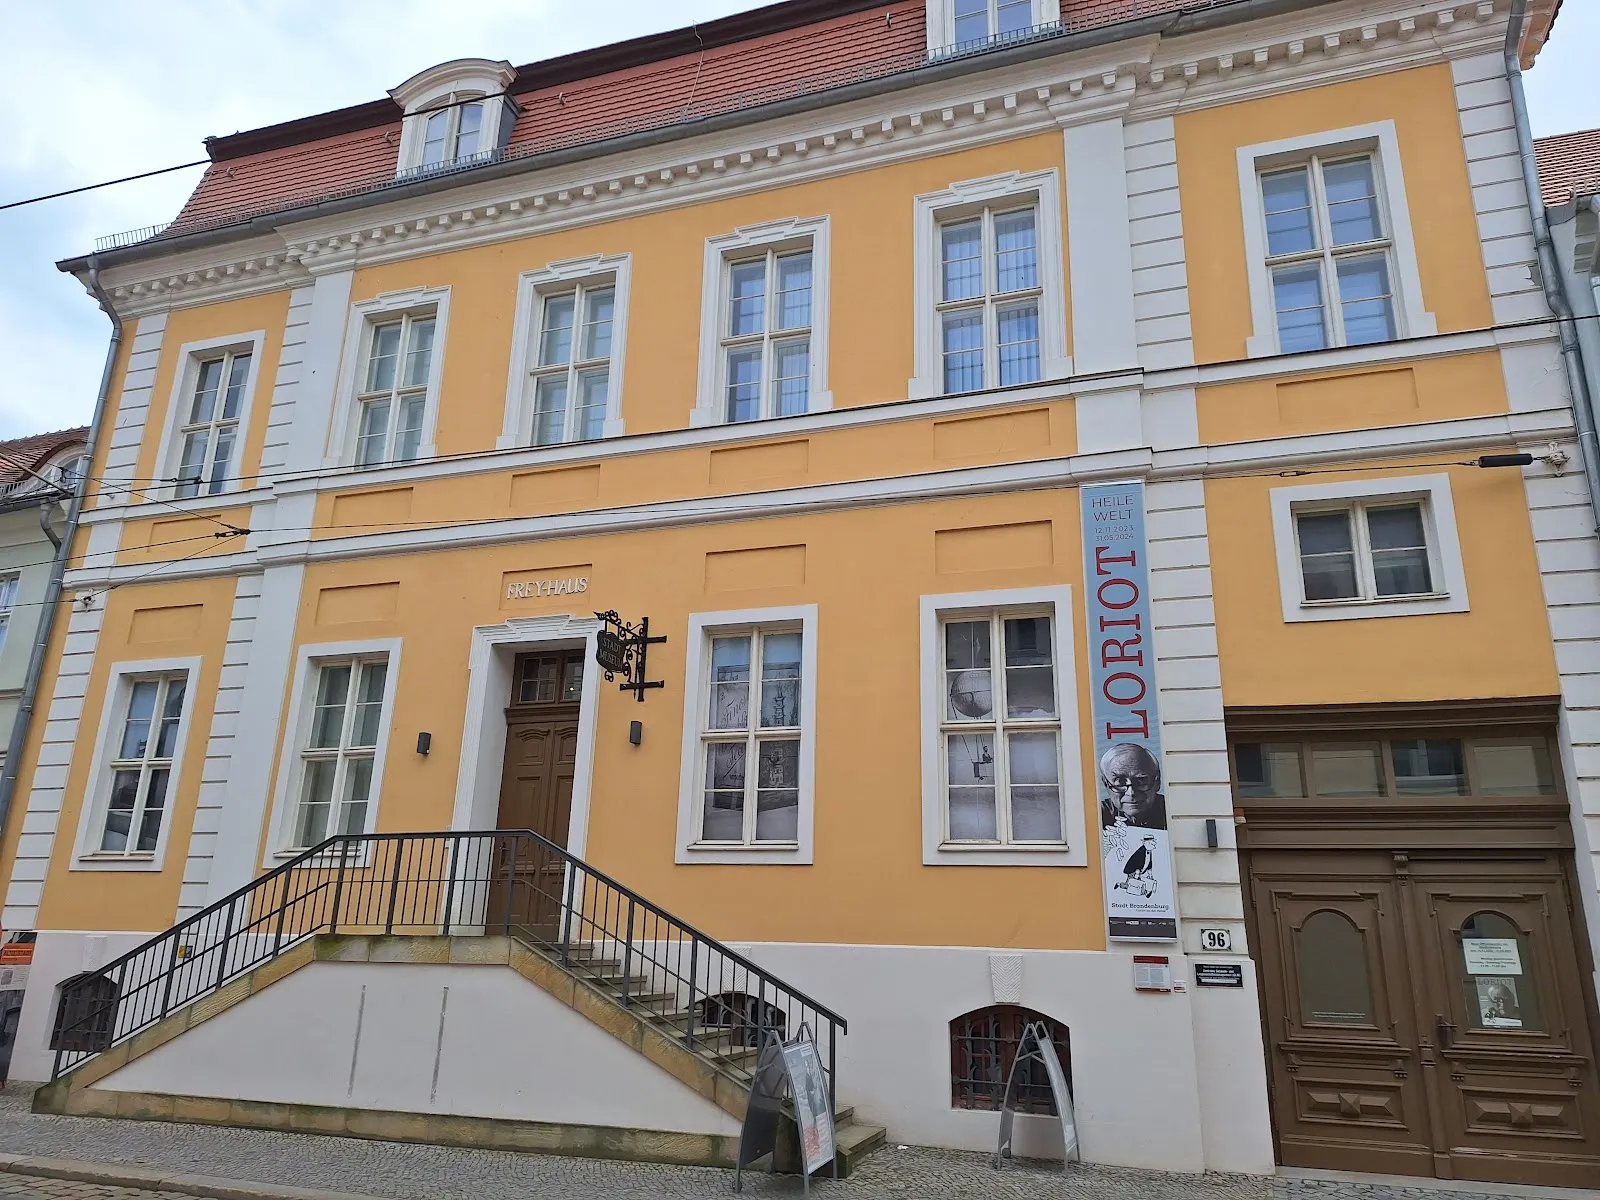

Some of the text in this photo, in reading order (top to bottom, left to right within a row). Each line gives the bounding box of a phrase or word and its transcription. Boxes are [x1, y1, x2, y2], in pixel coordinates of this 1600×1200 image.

[1092, 495, 1133, 508] HEILE
[1093, 509, 1133, 522] WELT
[1095, 525, 1134, 534] 12.11.2023
[1095, 533, 1134, 541] 31.05.2024
[506, 577, 588, 600] FREY-HAUS
[603, 637, 621, 654] STADT
[1095, 546, 1149, 739] LORIOT
[1208, 932, 1225, 948] 96
[1478, 978, 1513, 986] LORIOT
